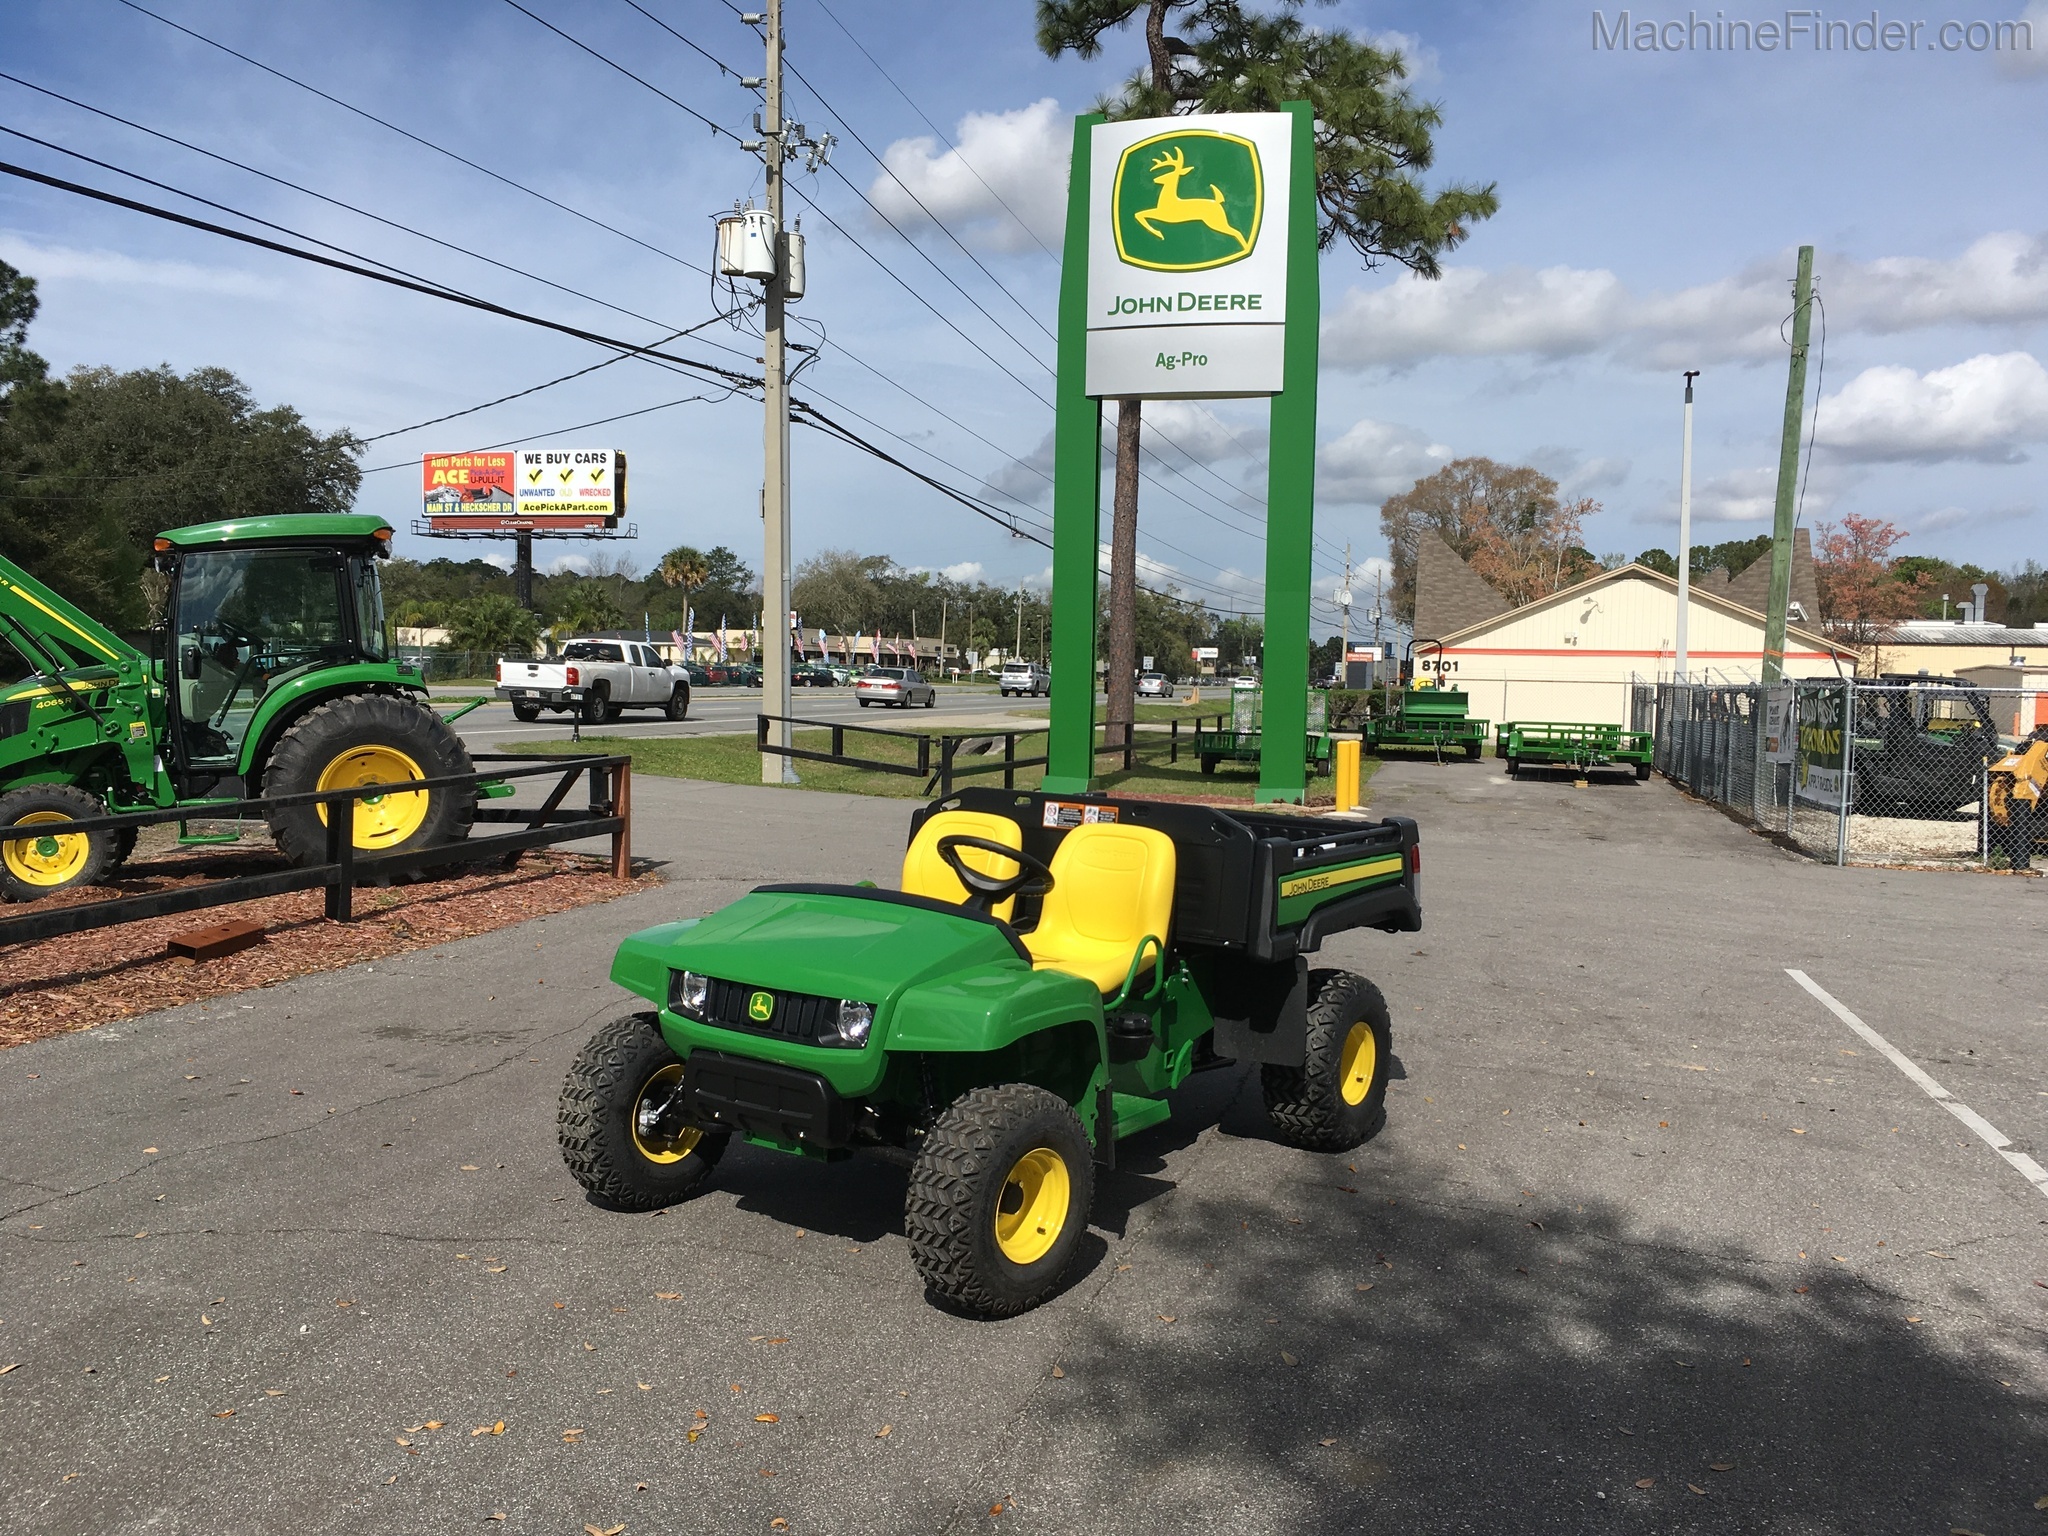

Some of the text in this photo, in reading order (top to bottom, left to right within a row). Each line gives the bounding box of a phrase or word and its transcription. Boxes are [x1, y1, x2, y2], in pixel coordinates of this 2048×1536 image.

[1107, 292, 1263, 316] JOHN DEERE
[1154, 351, 1208, 371] Ag-Pro
[430, 455, 506, 467] Auto Parts for Less
[524, 452, 607, 464] WE BUY CARS
[431, 469, 470, 485] ACE
[470, 476, 505, 484] U-PULL-IT
[519, 488, 556, 497] UNWANTED
[578, 488, 612, 497] WRECKED
[426, 502, 513, 513] MAIN ST & HECKSCHER DR
[523, 503, 608, 512] AcePickAPart.com
[1421, 659, 1459, 672] 8701
[82, 680, 108, 691] JOHN
[1289, 877, 1329, 895] JOHN DEERE
